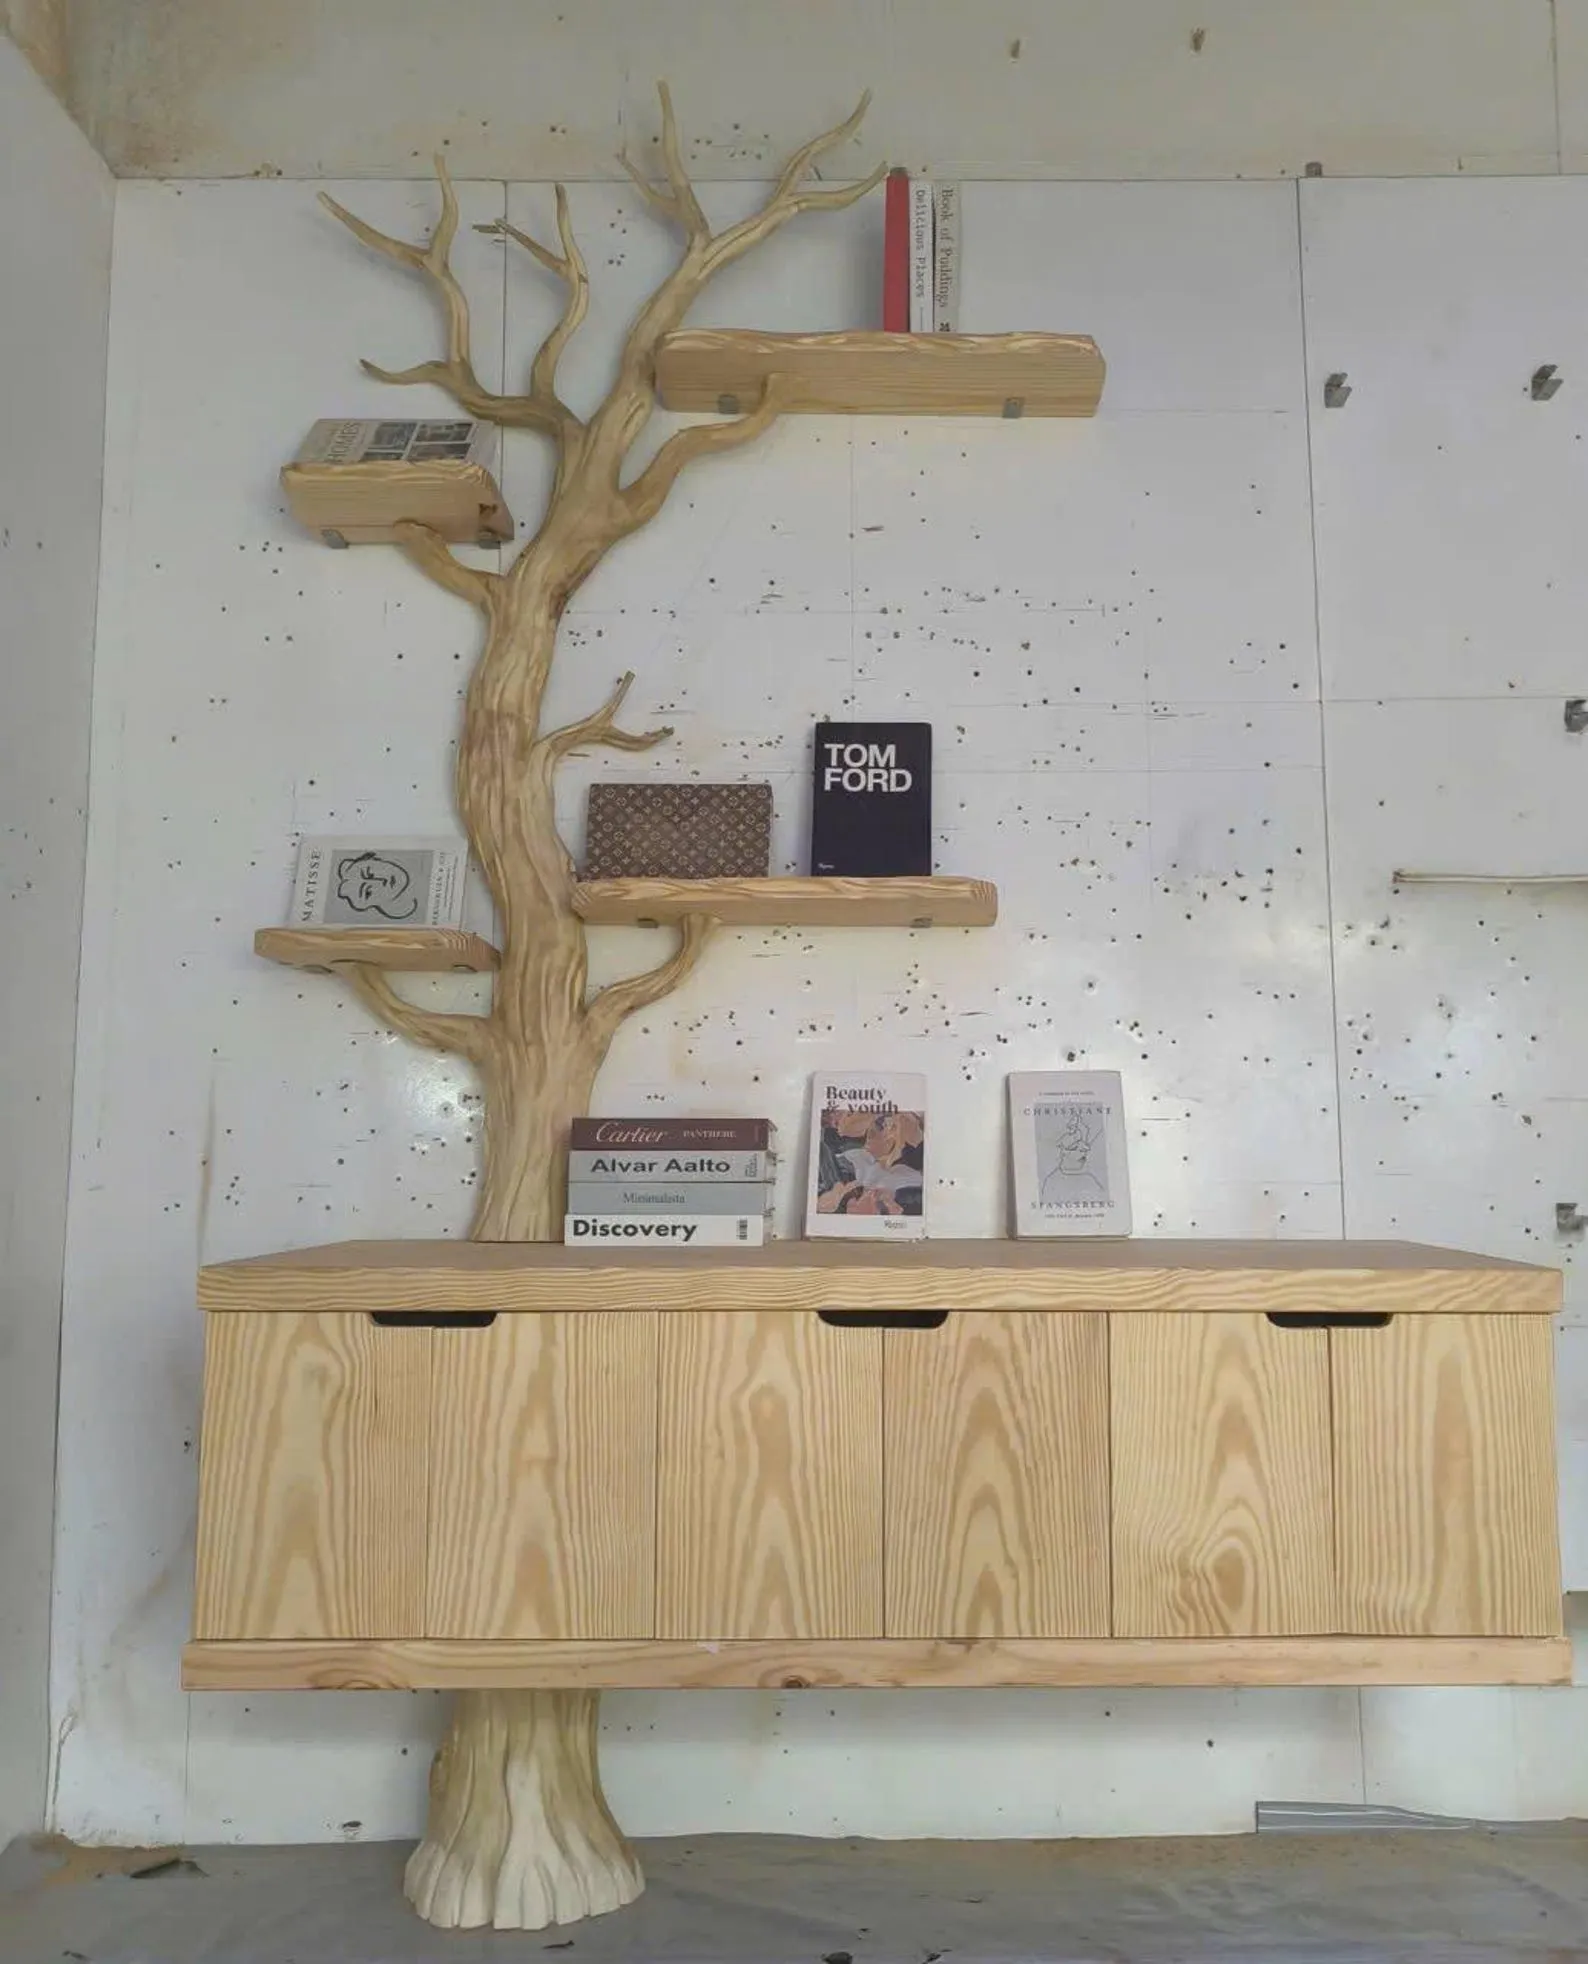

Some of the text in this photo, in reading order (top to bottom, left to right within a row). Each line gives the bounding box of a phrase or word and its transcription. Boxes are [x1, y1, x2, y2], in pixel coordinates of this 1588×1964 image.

[939, 188, 954, 221] Book
[939, 227, 954, 241] of
[915, 257, 927, 298] Places
[936, 247, 954, 308] Puddings
[824, 743, 896, 768] TOM
[824, 767, 912, 792] FORD
[301, 850, 321, 921] MATISSE
[826, 1086, 886, 1102] Beauty
[848, 1100, 899, 1115] youth
[596, 1120, 666, 1143] Cartier
[590, 1158, 658, 1173] Alvar
[664, 1158, 731, 1173] Aalto
[573, 1218, 698, 1242] Discovery
